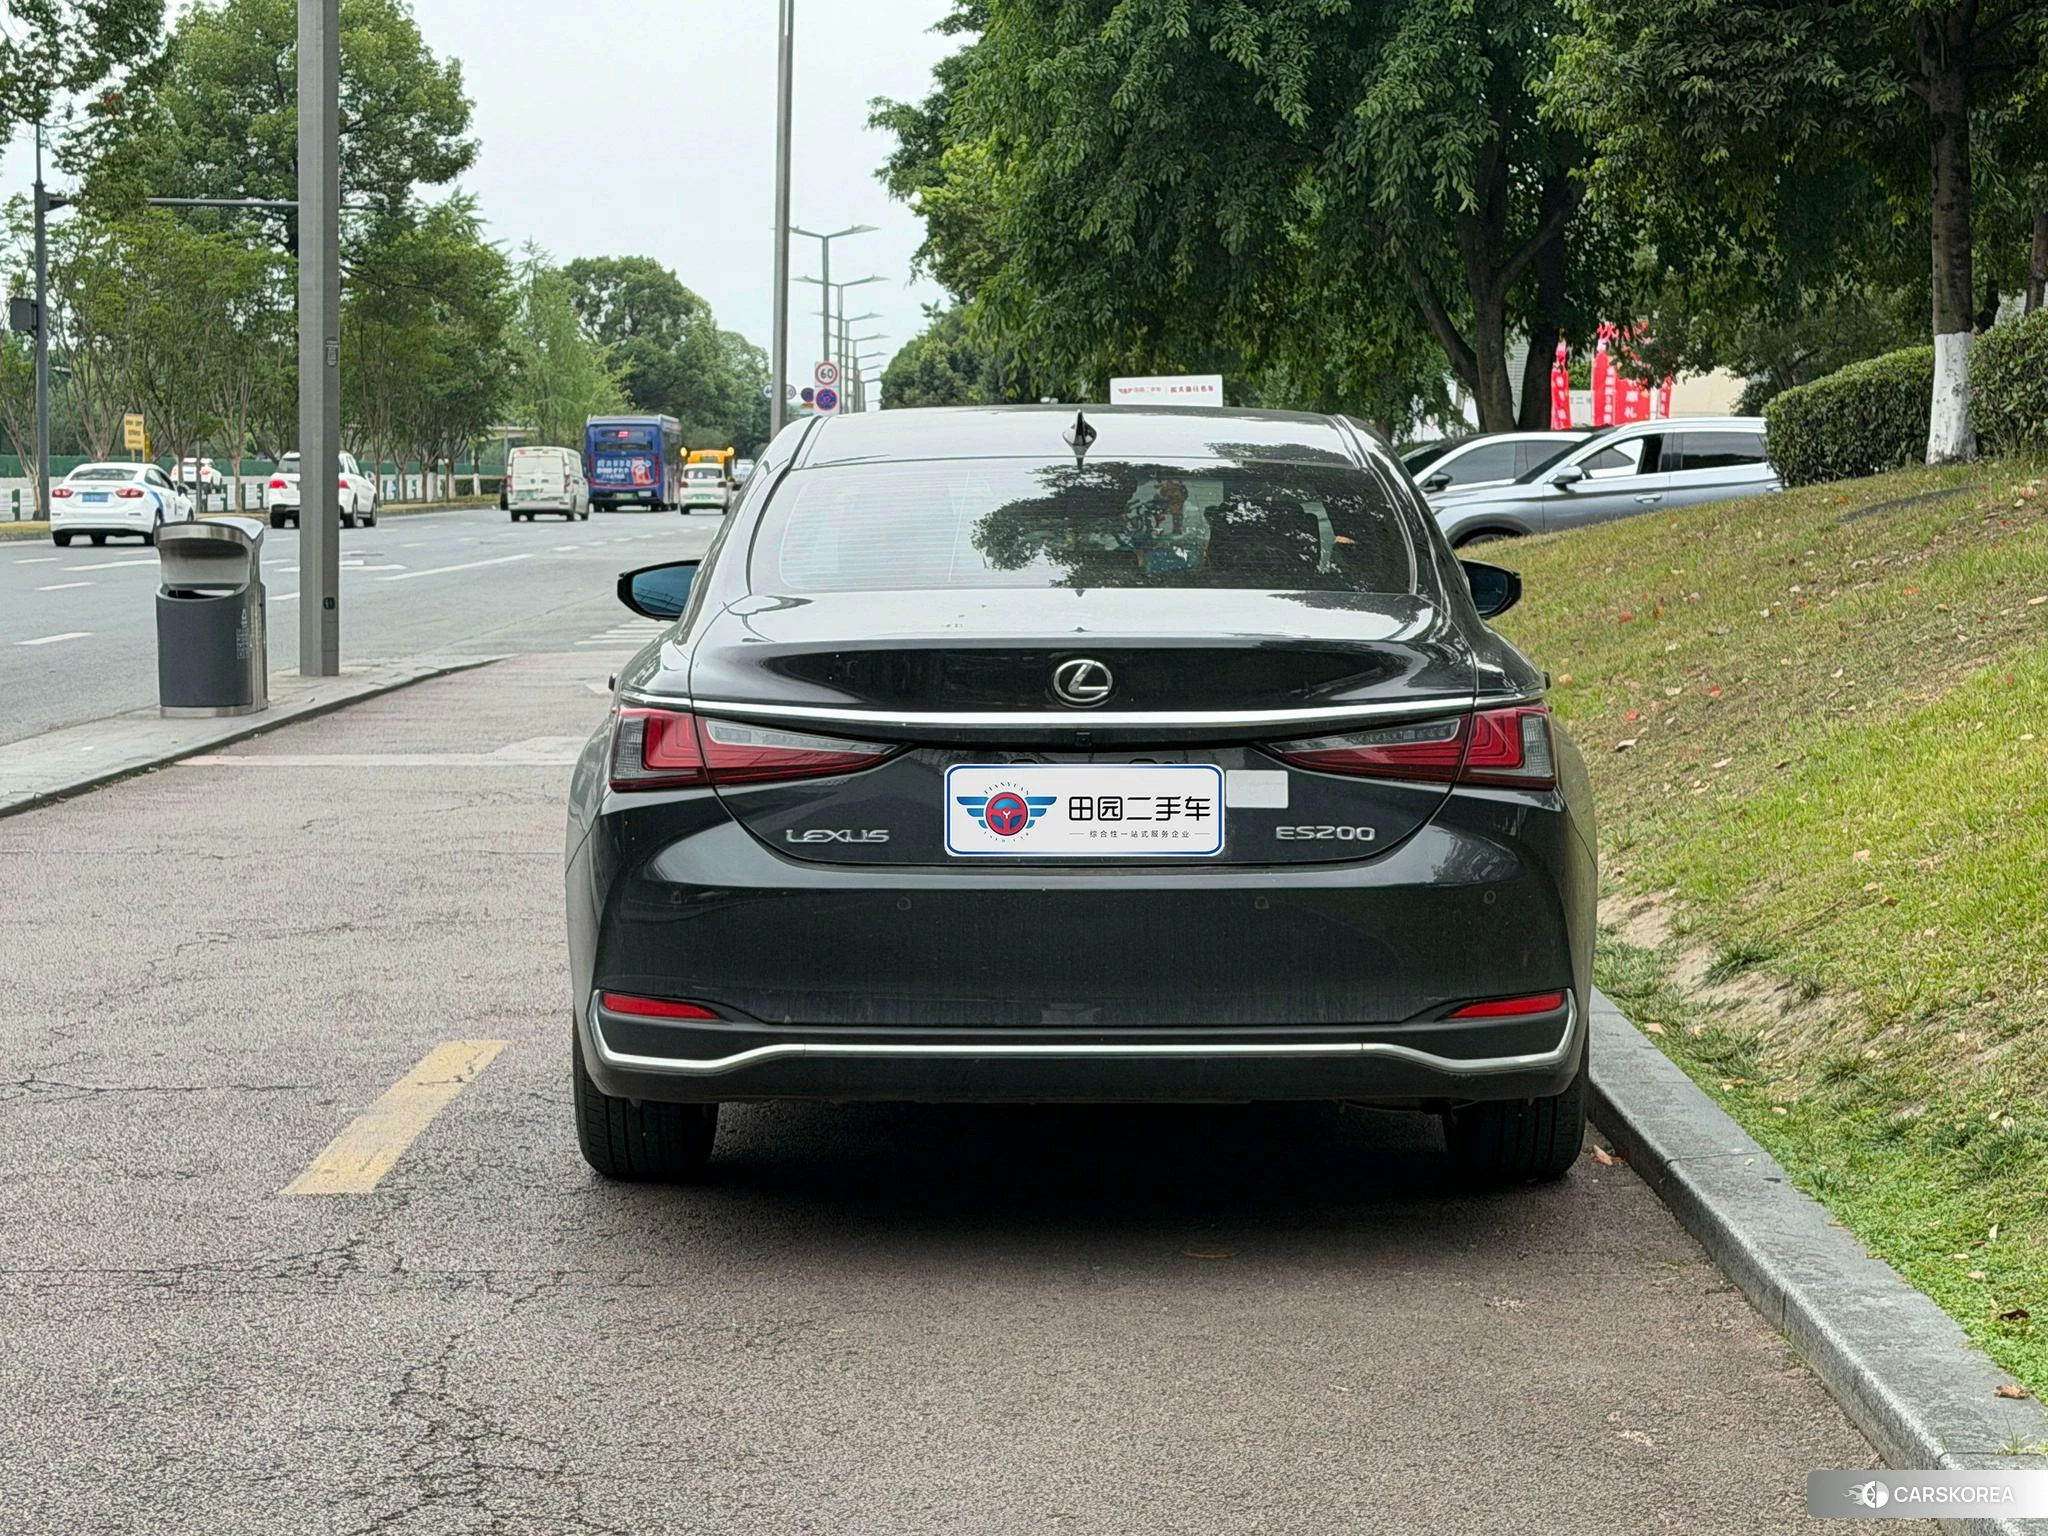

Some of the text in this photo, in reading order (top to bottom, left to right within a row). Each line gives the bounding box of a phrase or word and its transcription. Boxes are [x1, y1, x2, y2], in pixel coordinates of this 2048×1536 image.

[820, 368, 834, 379] 60
[785, 829, 890, 843] LEXUS
[1275, 825, 1376, 842] ES200
